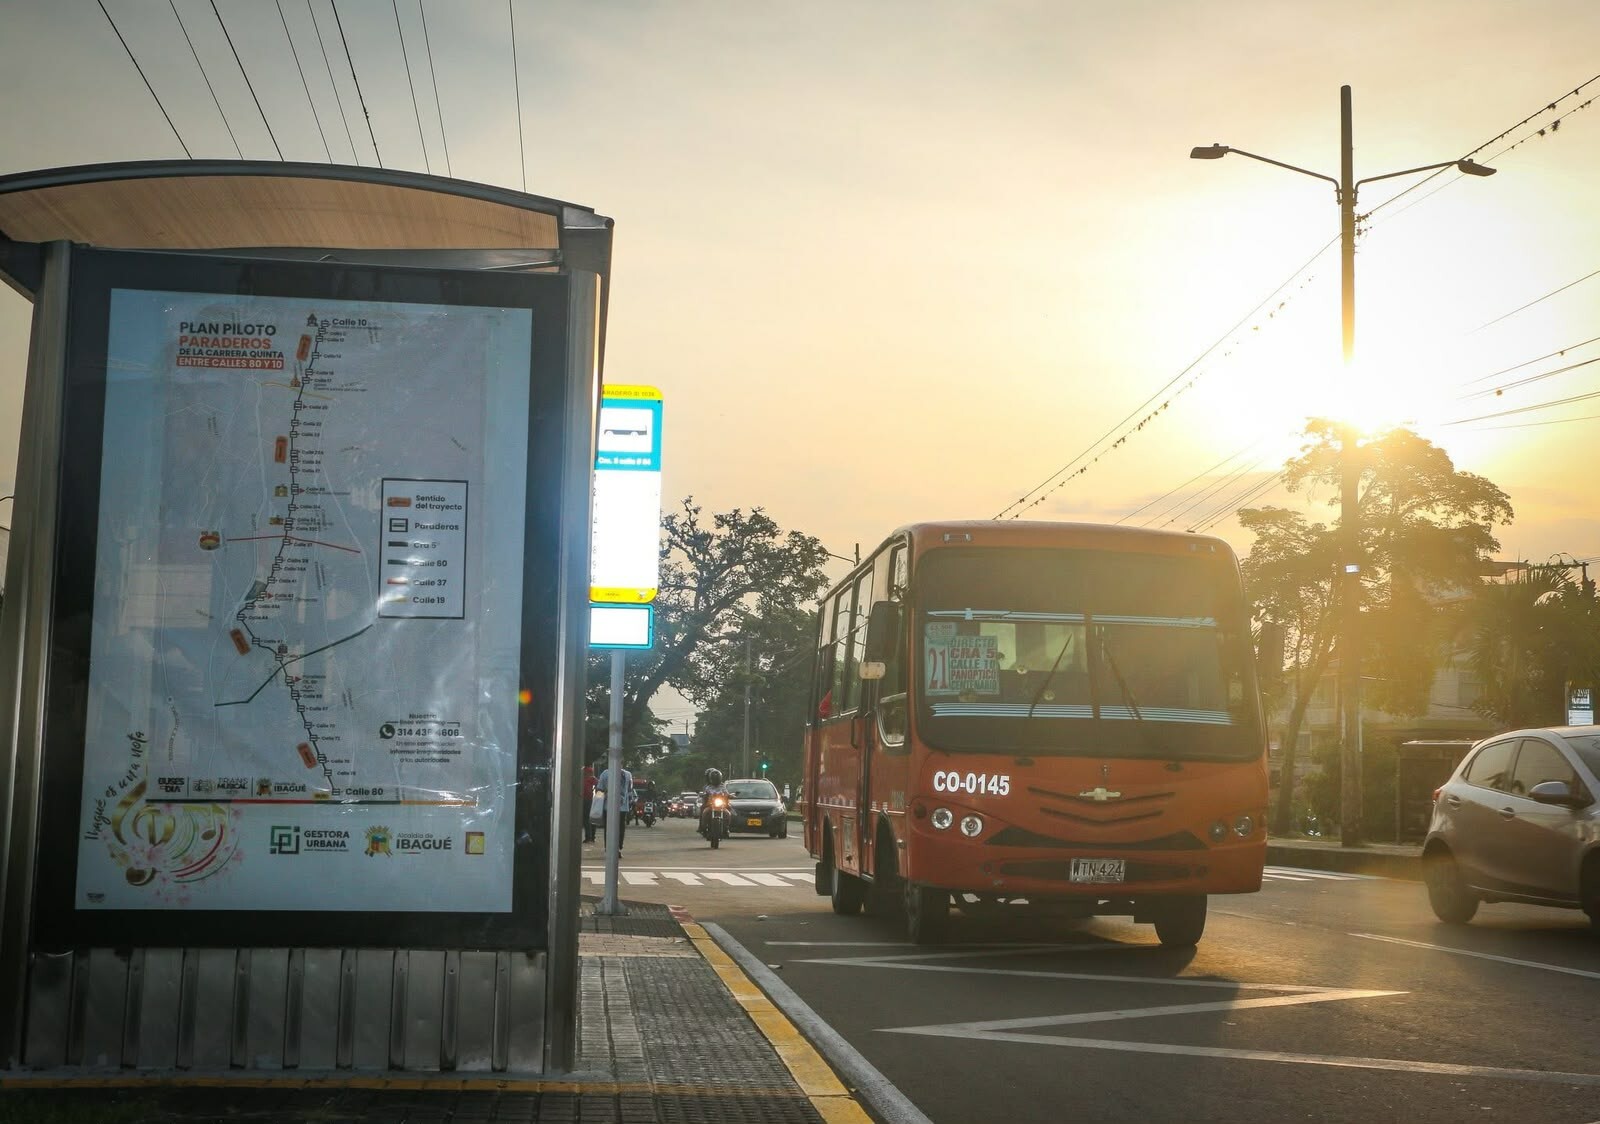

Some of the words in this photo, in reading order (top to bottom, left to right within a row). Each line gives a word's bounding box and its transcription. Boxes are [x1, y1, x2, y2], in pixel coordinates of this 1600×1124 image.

[333, 318, 357, 327] Calle
[358, 318, 368, 327] 10
[179, 321, 220, 336] PLAN
[222, 322, 277, 337] PILOTO
[179, 335, 272, 350] PARADEROS
[179, 347, 192, 356] DE
[193, 348, 204, 357] LA
[205, 349, 248, 358] CARRERA
[249, 350, 284, 359] QUINTA
[178, 357, 210, 367] ENTRE
[211, 358, 247, 368] CALLES
[248, 359, 262, 369] 80
[264, 360, 271, 369] Y
[271, 360, 283, 370] 10
[415, 494, 446, 503] Sentido
[415, 502, 428, 511] del
[429, 503, 463, 513] trayecto
[414, 521, 460, 532] Paraderos
[436, 579, 448, 588] 37
[412, 596, 435, 605] Calle
[436, 596, 447, 605] 19
[950, 647, 981, 659] CRA
[985, 648, 997, 659] 5
[927, 647, 949, 690] 21
[950, 659, 980, 669] CALLE
[983, 659, 998, 669] 10
[950, 669, 998, 680] PANOPTICO
[950, 680, 998, 691] CENTENARIO
[397, 728, 413, 737] 314
[273, 783, 307, 793] IBAGUÉ
[933, 770, 1010, 796] CO-0145
[345, 788, 370, 796] Calle
[371, 788, 384, 796] 80
[303, 829, 351, 839] GESTORA
[306, 839, 347, 849] URBANA
[395, 836, 453, 850] IBAGUÉ
[1099, 862, 1123, 877] 424
